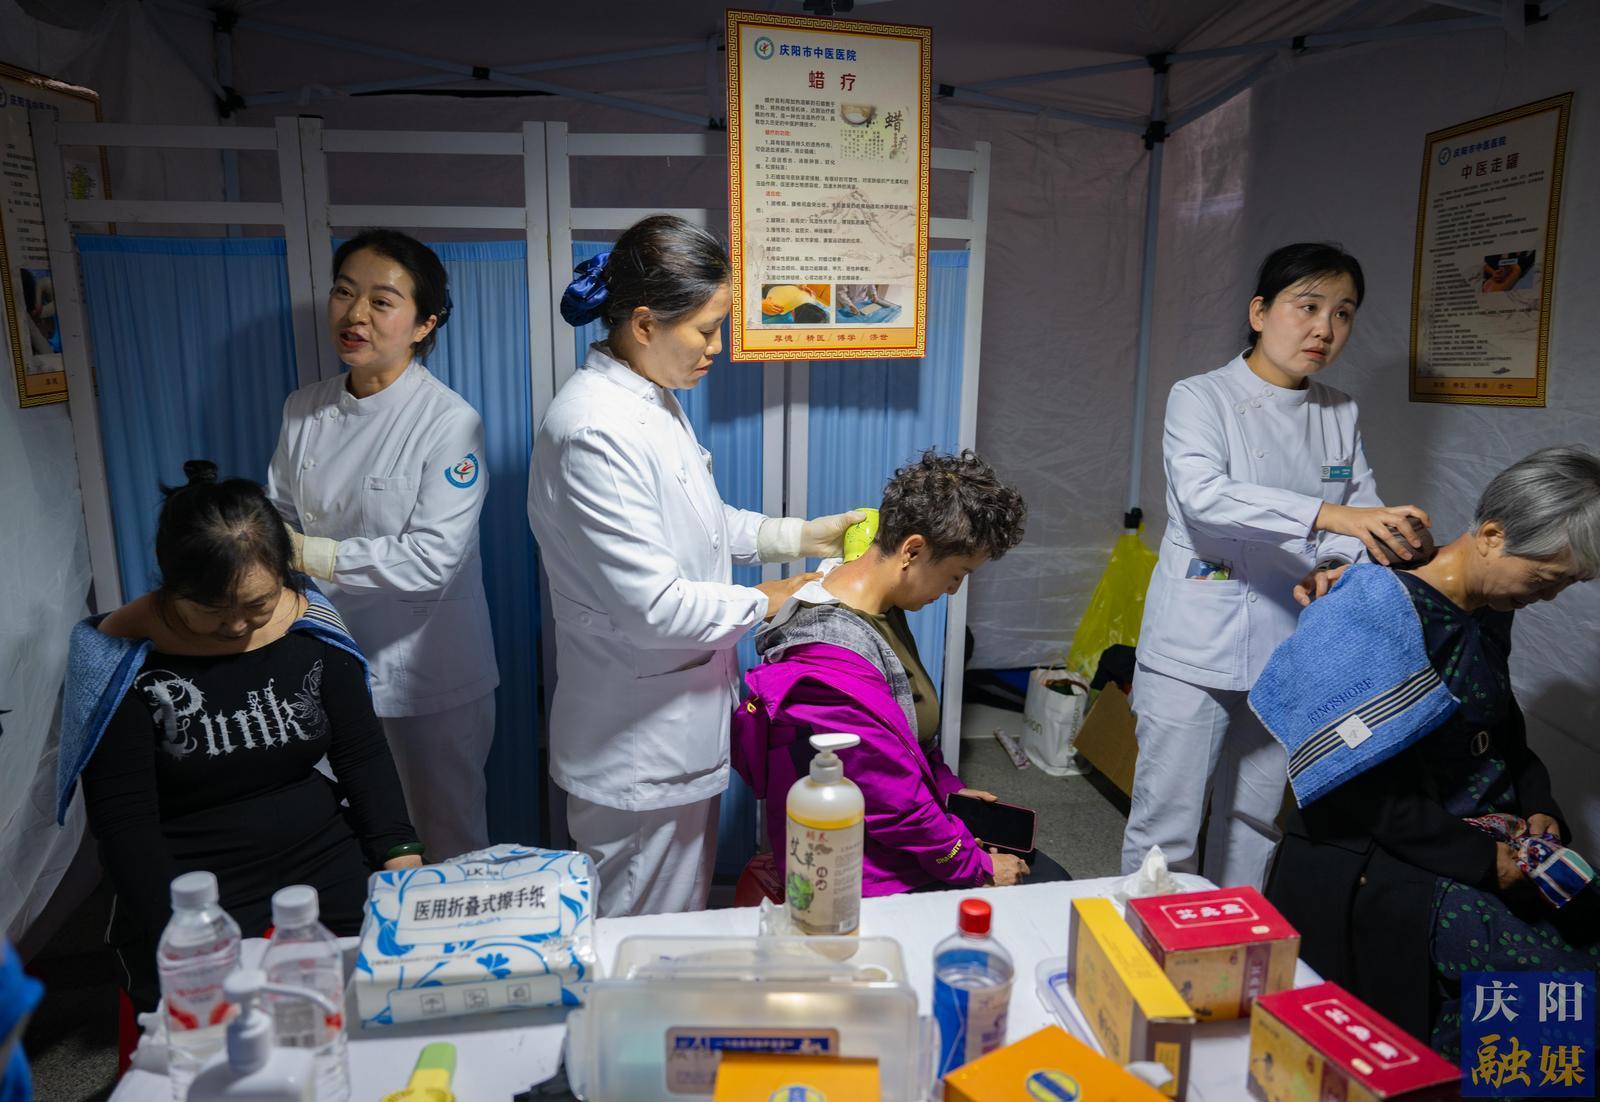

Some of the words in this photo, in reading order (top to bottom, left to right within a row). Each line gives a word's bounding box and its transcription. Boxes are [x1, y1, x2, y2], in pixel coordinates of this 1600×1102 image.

[779, 44, 857, 61] 庆阳市中医医院
[808, 70, 857, 91] 蜡疗
[1461, 152, 1520, 180] 中医走罐
[136, 670, 310, 760] Punk
[414, 885, 546, 921] 医用折叠式擦手纸
